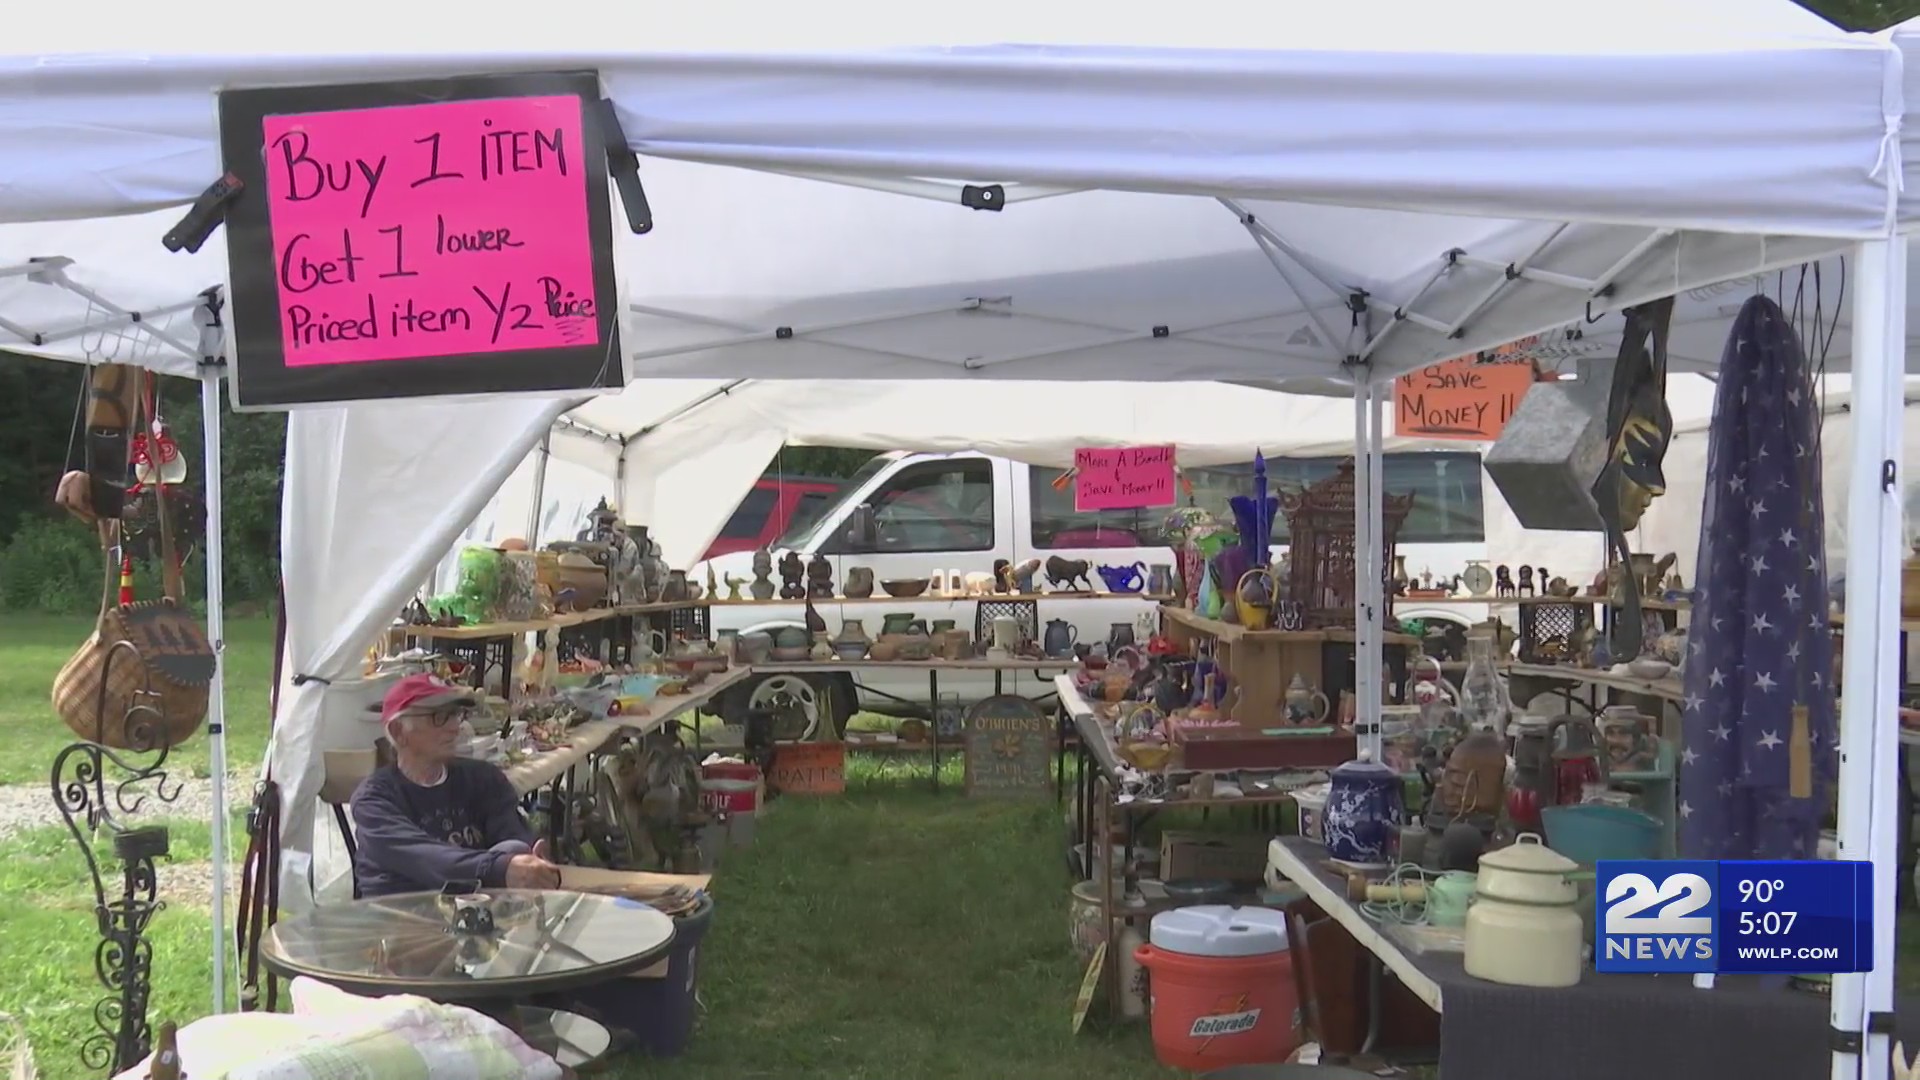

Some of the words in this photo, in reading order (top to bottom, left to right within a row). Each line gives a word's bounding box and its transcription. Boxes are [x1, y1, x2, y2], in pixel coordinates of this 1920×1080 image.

[272, 130, 387, 218] Buy
[411, 133, 464, 188] 1
[281, 228, 364, 293] Get
[378, 224, 418, 279] 1
[288, 293, 378, 349] Priced
[392, 298, 470, 338] item
[538, 276, 597, 319] Price
[1117, 451, 1126, 467] A
[1193, 1014, 1256, 1034] Gatorade
